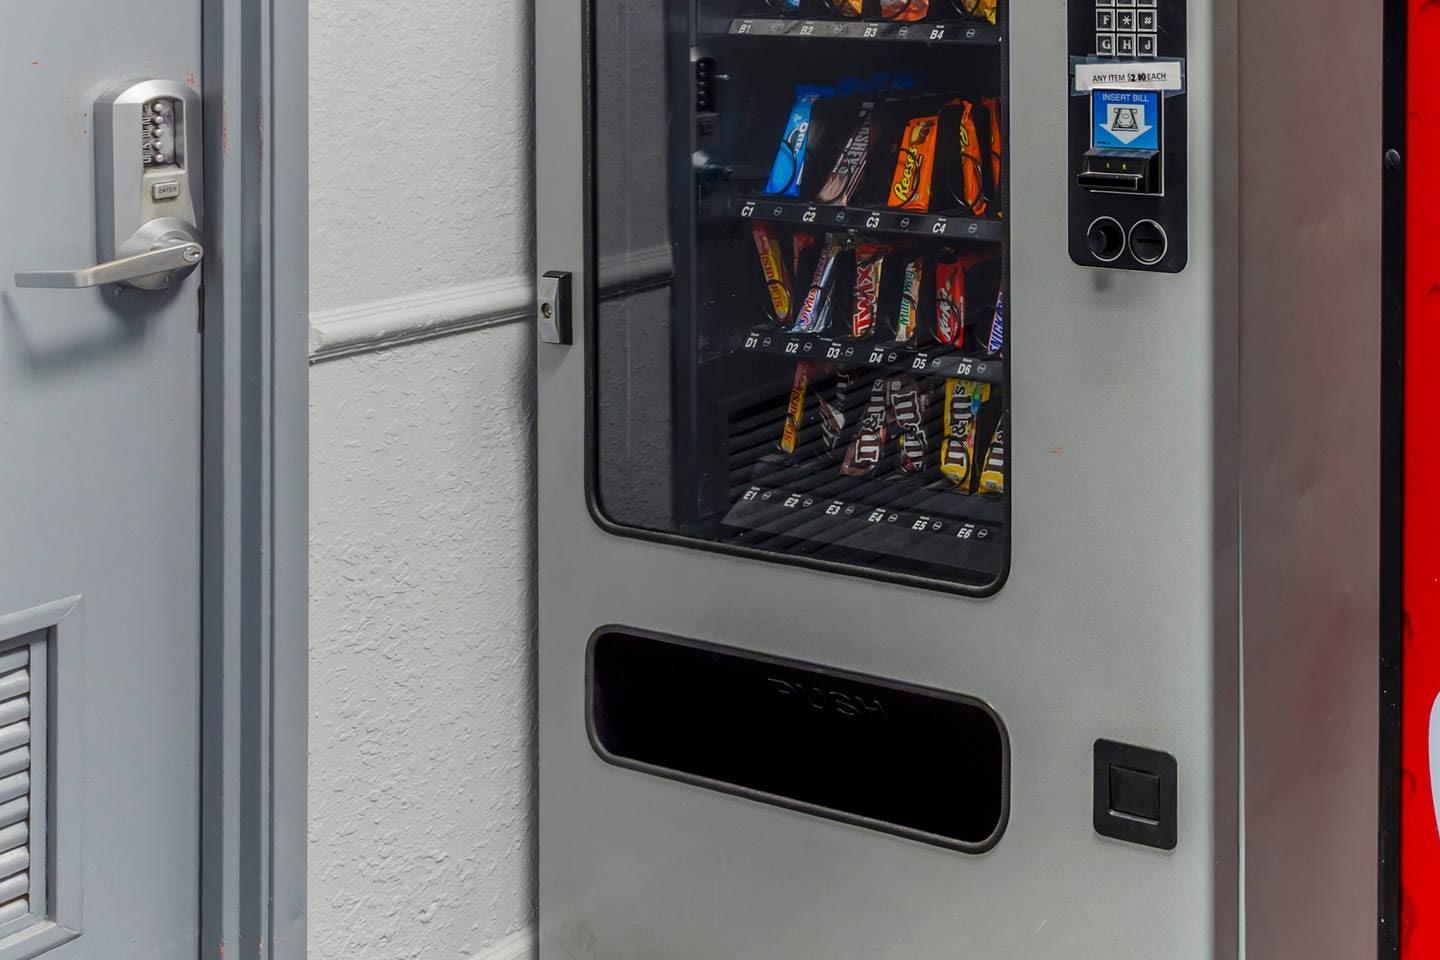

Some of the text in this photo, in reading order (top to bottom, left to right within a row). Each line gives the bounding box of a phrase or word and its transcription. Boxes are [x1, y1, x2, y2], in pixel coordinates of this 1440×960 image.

[1103, 16, 1110, 25] F
[738, 24, 751, 33] B1
[800, 25, 814, 36] B2
[864, 27, 878, 37] B3
[929, 29, 944, 39] B4
[1102, 40, 1111, 50] G
[1123, 40, 1131, 50] H
[1092, 74, 1107, 83] ANY
[1108, 73, 1126, 82] ITEM
[1147, 72, 1167, 81] EACH
[1102, 93, 1149, 102] INSERT BILL
[158, 187, 177, 195] ENTER
[741, 206, 754, 216] C1
[803, 211, 817, 222] C2
[866, 217, 880, 228] C3
[932, 223, 947, 234] C4
[853, 263, 875, 337] TWIX
[745, 337, 758, 348] D1
[785, 343, 799, 353] D2
[827, 347, 841, 358] D3
[869, 352, 883, 363] D4
[912, 357, 927, 369] D5
[957, 363, 972, 375] D6
[743, 491, 757, 501] E1
[784, 497, 799, 507] E2
[825, 505, 840, 515] E3
[868, 512, 884, 523] E4
[912, 520, 928, 531] E5
[956, 528, 973, 539] E6
